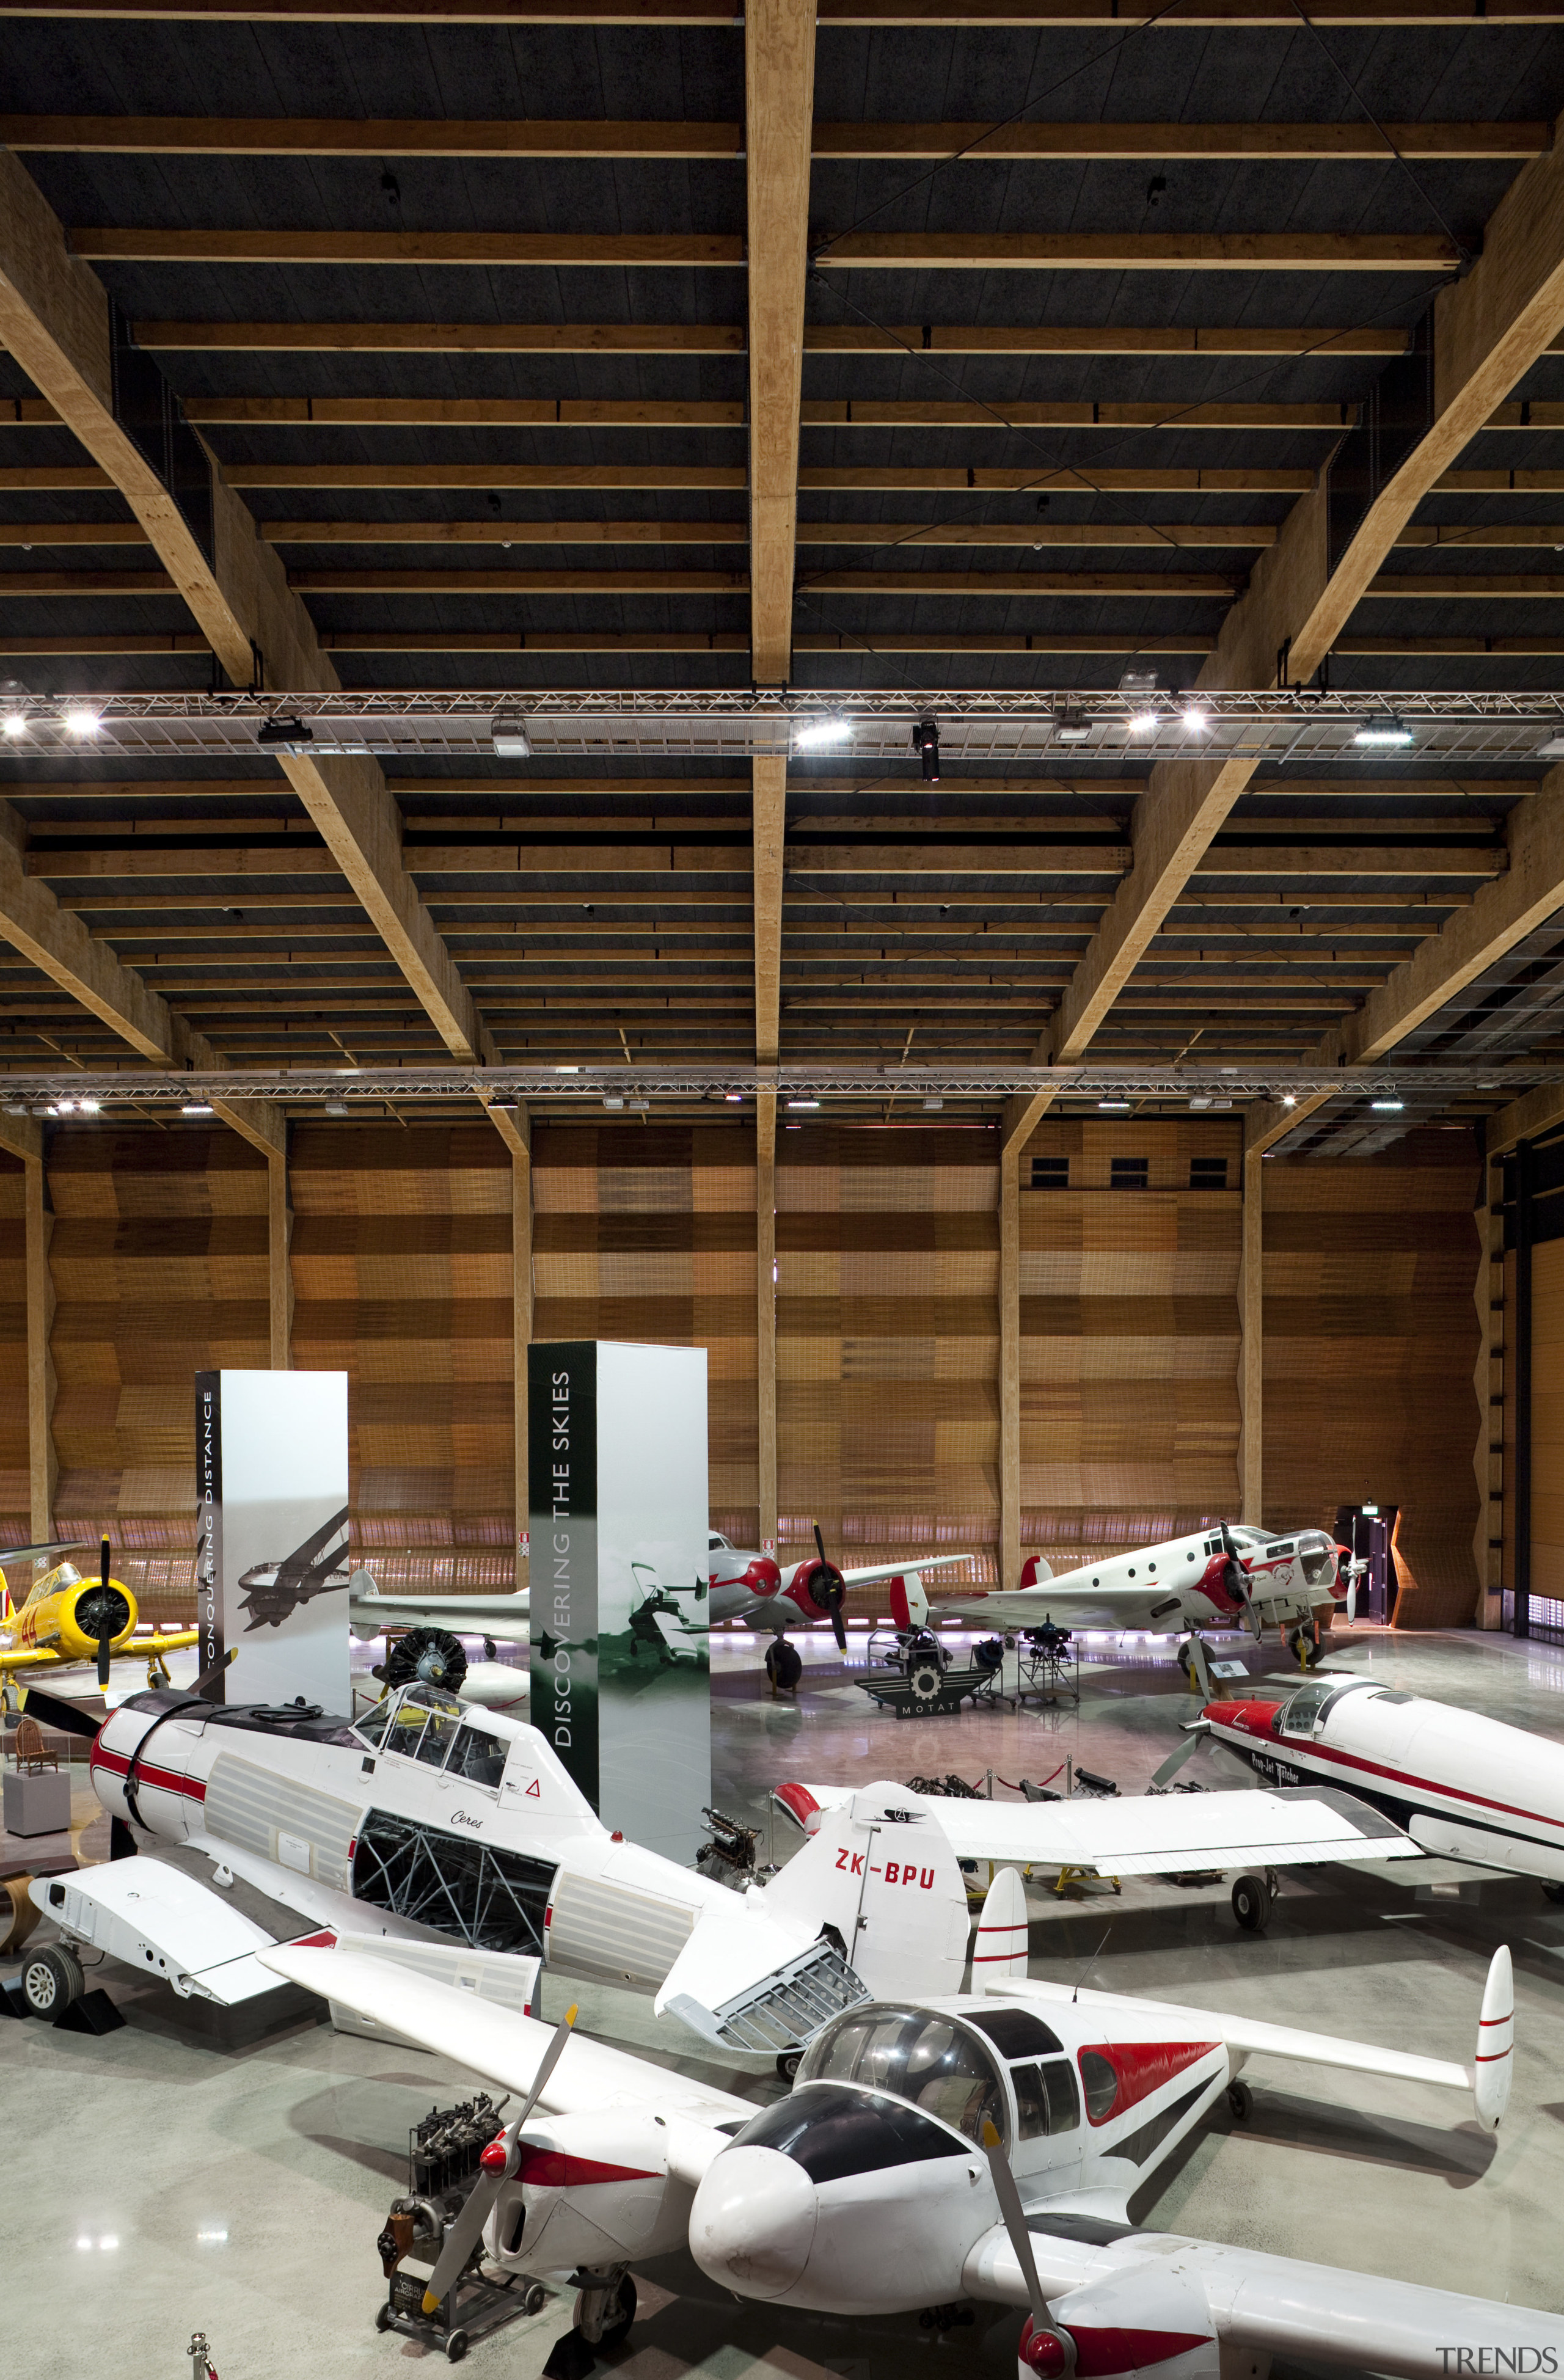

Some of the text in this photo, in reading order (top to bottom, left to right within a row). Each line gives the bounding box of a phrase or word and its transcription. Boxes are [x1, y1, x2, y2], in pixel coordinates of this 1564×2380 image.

[204, 1392, 213, 1504] DISTANCE
[552, 1372, 571, 1747] DISCOVERING THE SKIES
[22, 1607, 38, 1649] 44
[902, 1703, 954, 1715] MOTAT
[1252, 1753, 1274, 1774] Prop-Jet
[450, 1810, 483, 1828] Ceres
[835, 1847, 935, 1889] ZK-BPU
[394, 2287, 425, 2300] AIRCRAF
